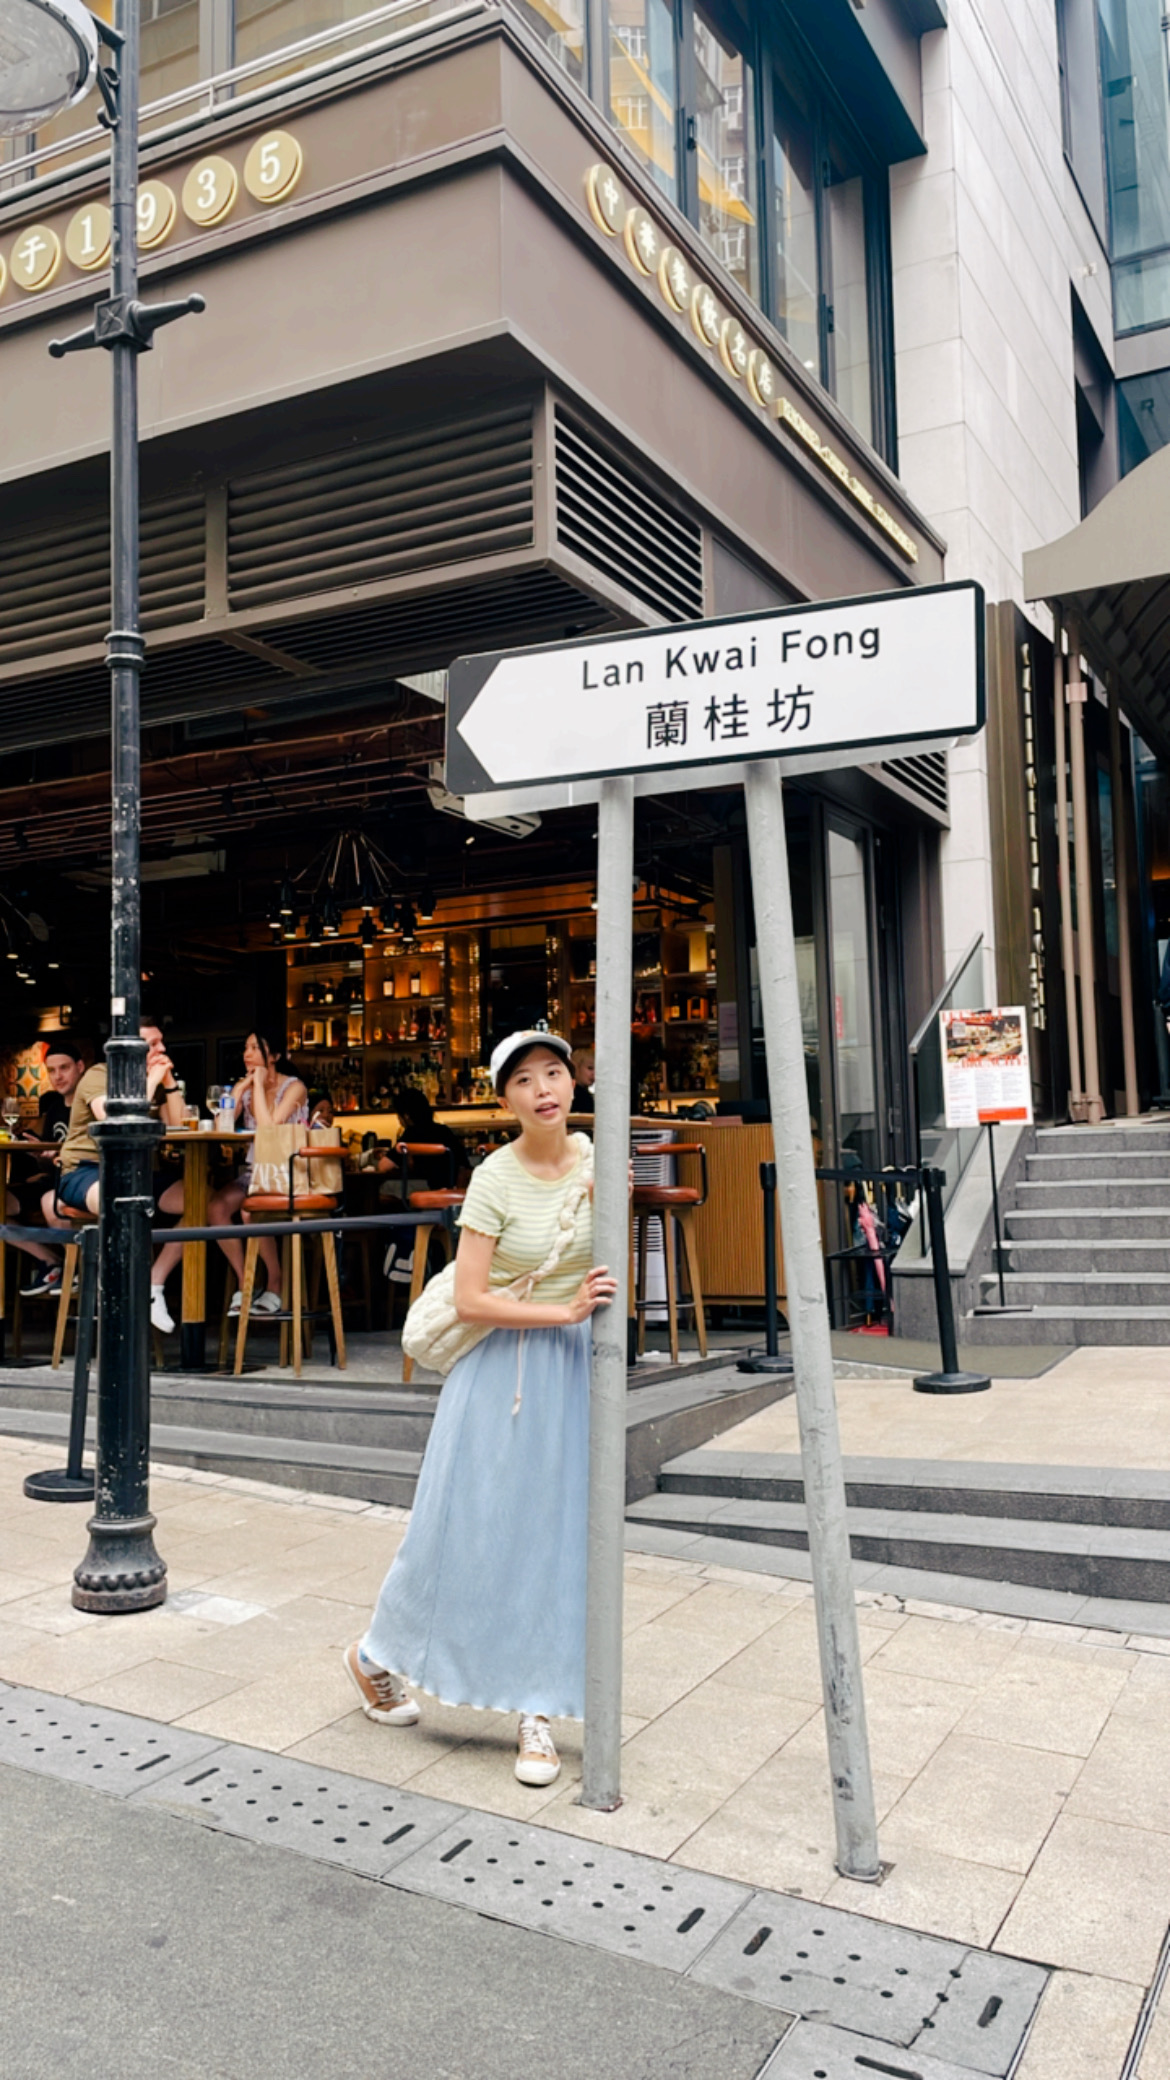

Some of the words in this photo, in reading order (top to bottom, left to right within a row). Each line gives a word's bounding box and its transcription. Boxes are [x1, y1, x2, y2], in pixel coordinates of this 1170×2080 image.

[582, 660, 644, 690] Lan
[665, 636, 757, 679] Kwai
[781, 627, 880, 663] Fong
[645, 684, 815, 750] 蘭桂坊
